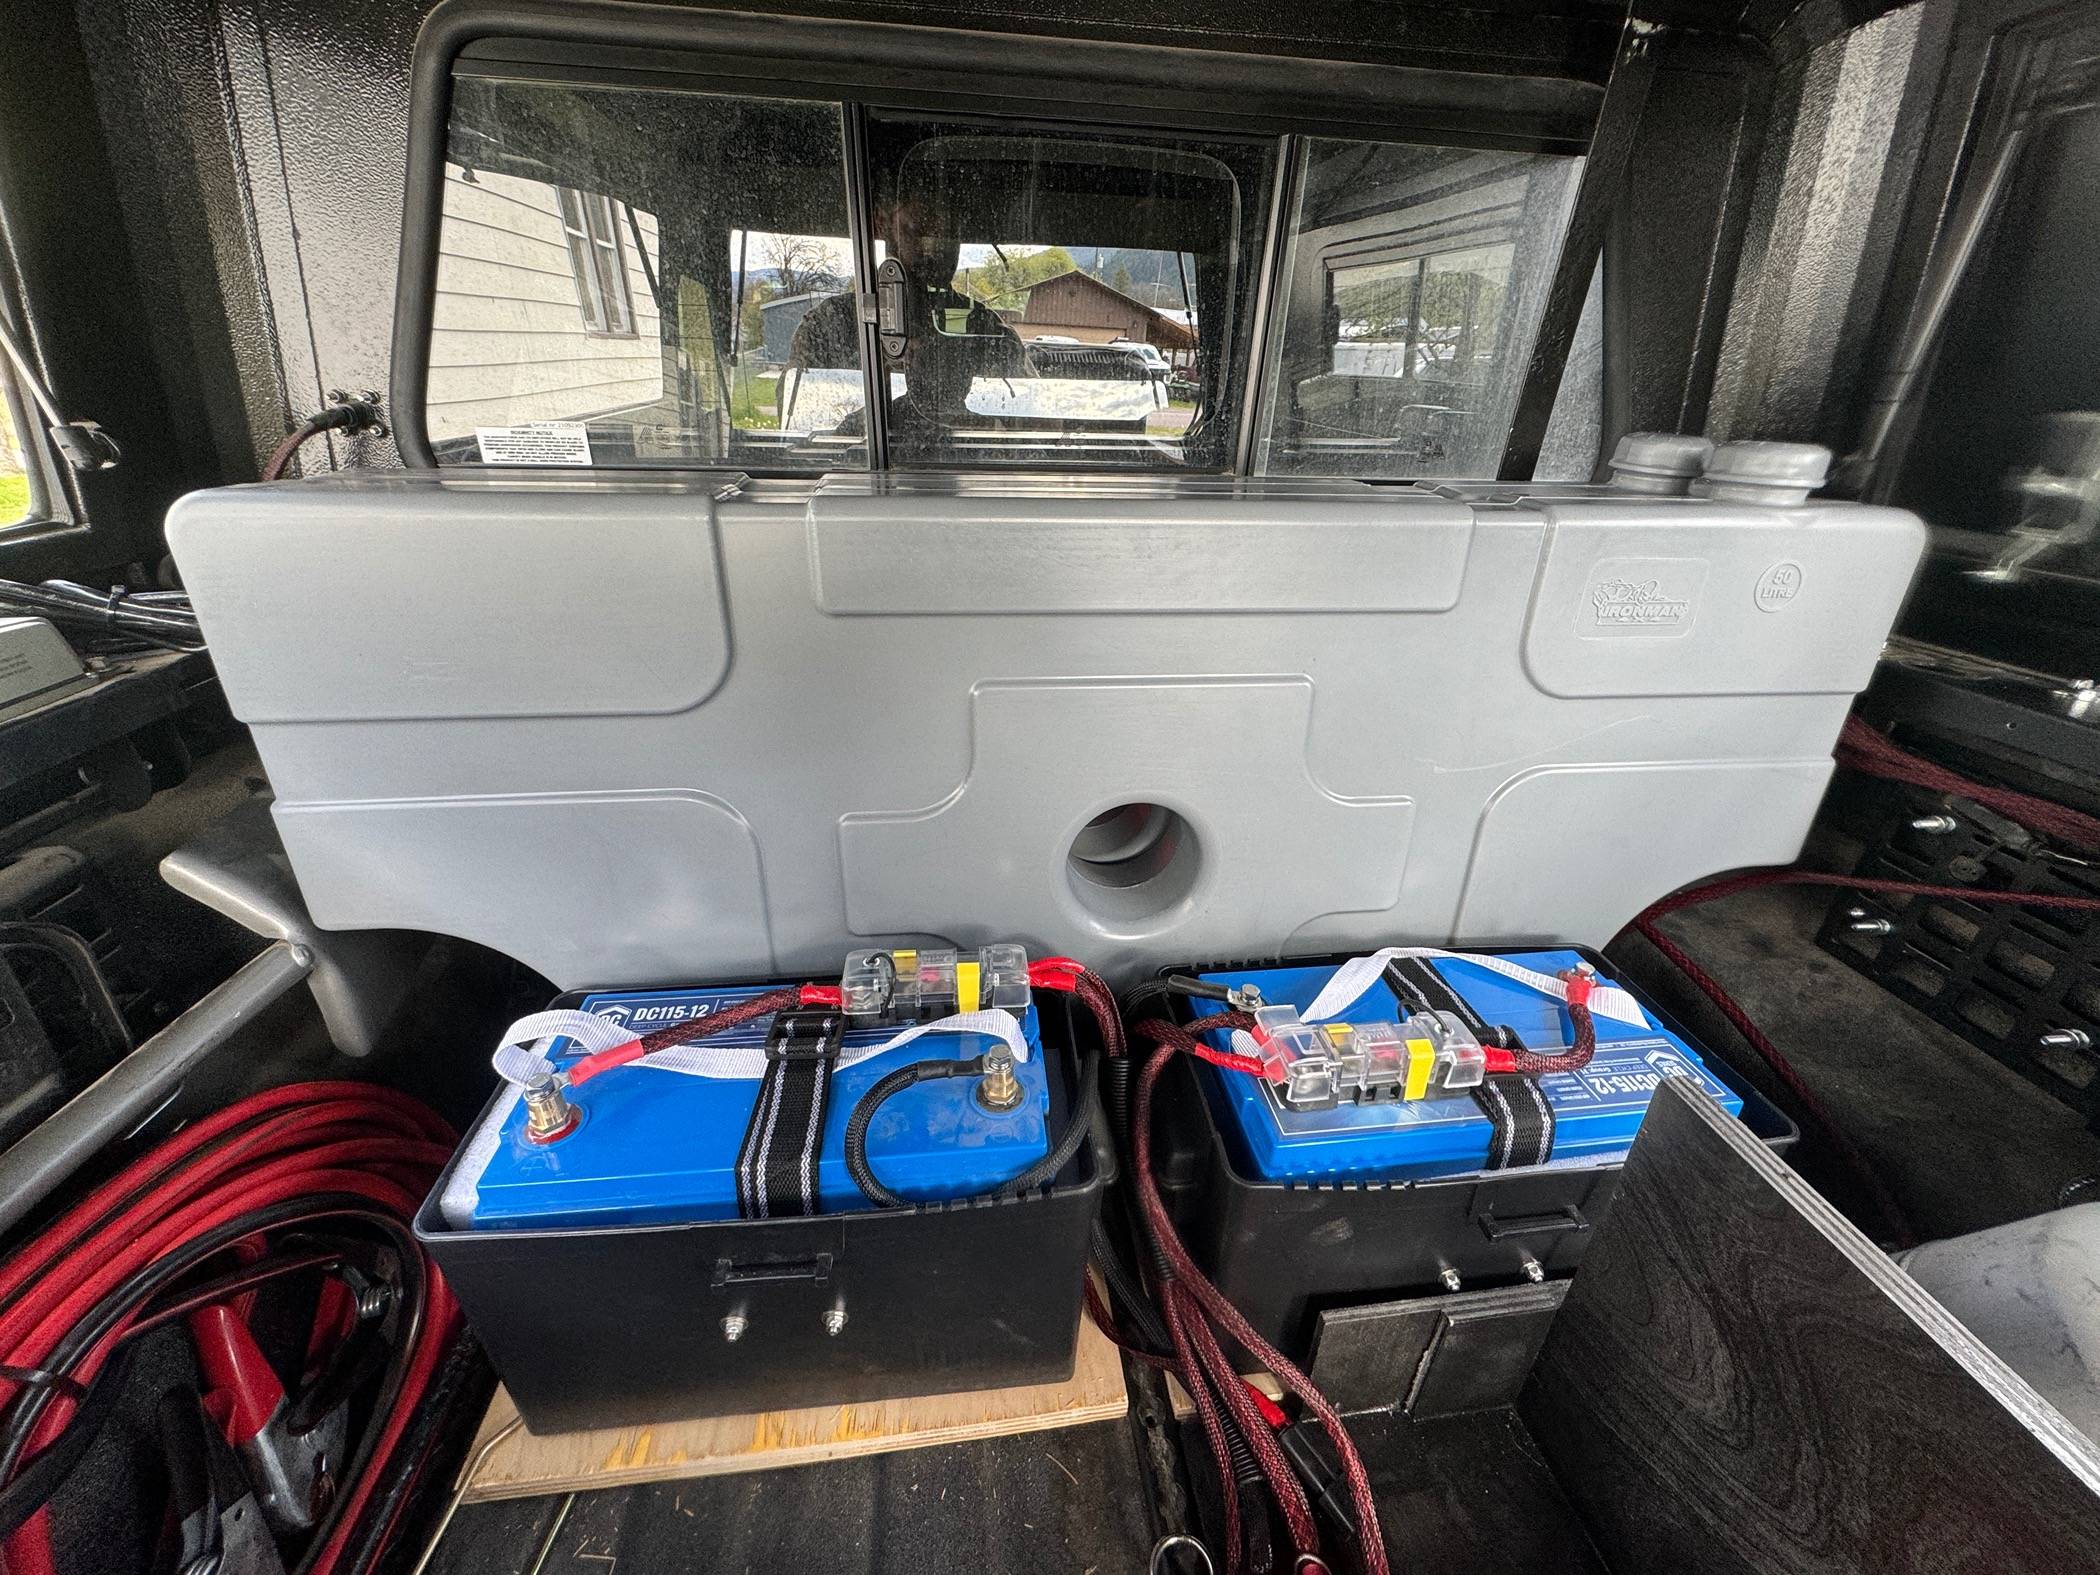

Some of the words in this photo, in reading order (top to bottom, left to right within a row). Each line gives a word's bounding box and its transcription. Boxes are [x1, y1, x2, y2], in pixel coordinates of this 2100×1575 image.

[1773, 568, 1792, 585] 50
[1760, 586, 1793, 599] LITRE
[1600, 604, 1684, 618] IRONMAN
[633, 1004, 709, 1020] DC115-12
